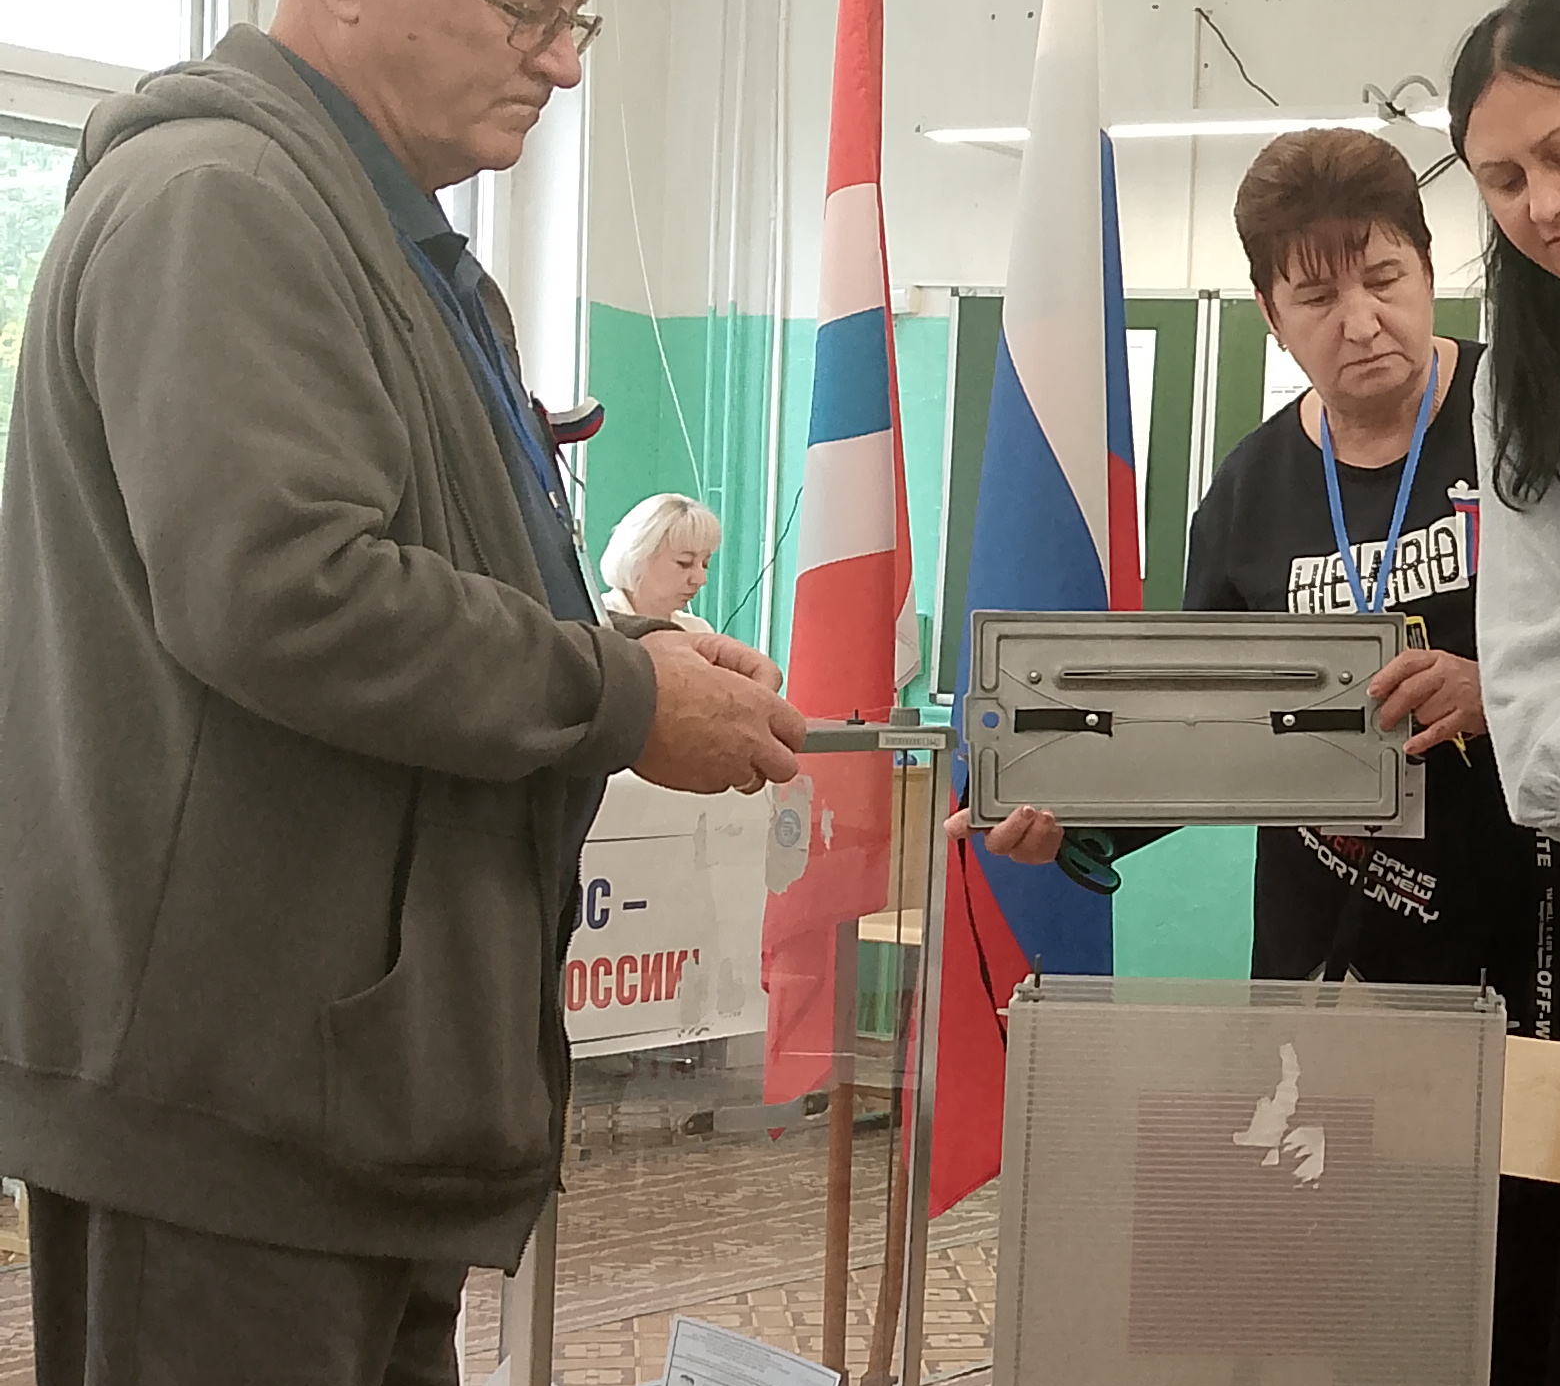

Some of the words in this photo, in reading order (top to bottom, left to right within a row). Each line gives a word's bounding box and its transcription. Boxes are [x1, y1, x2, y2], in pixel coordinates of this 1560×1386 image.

[1367, 861, 1385, 878] A
[1386, 872, 1433, 901] NEW
[1372, 849, 1415, 878] DAY
[1416, 871, 1437, 889] IS
